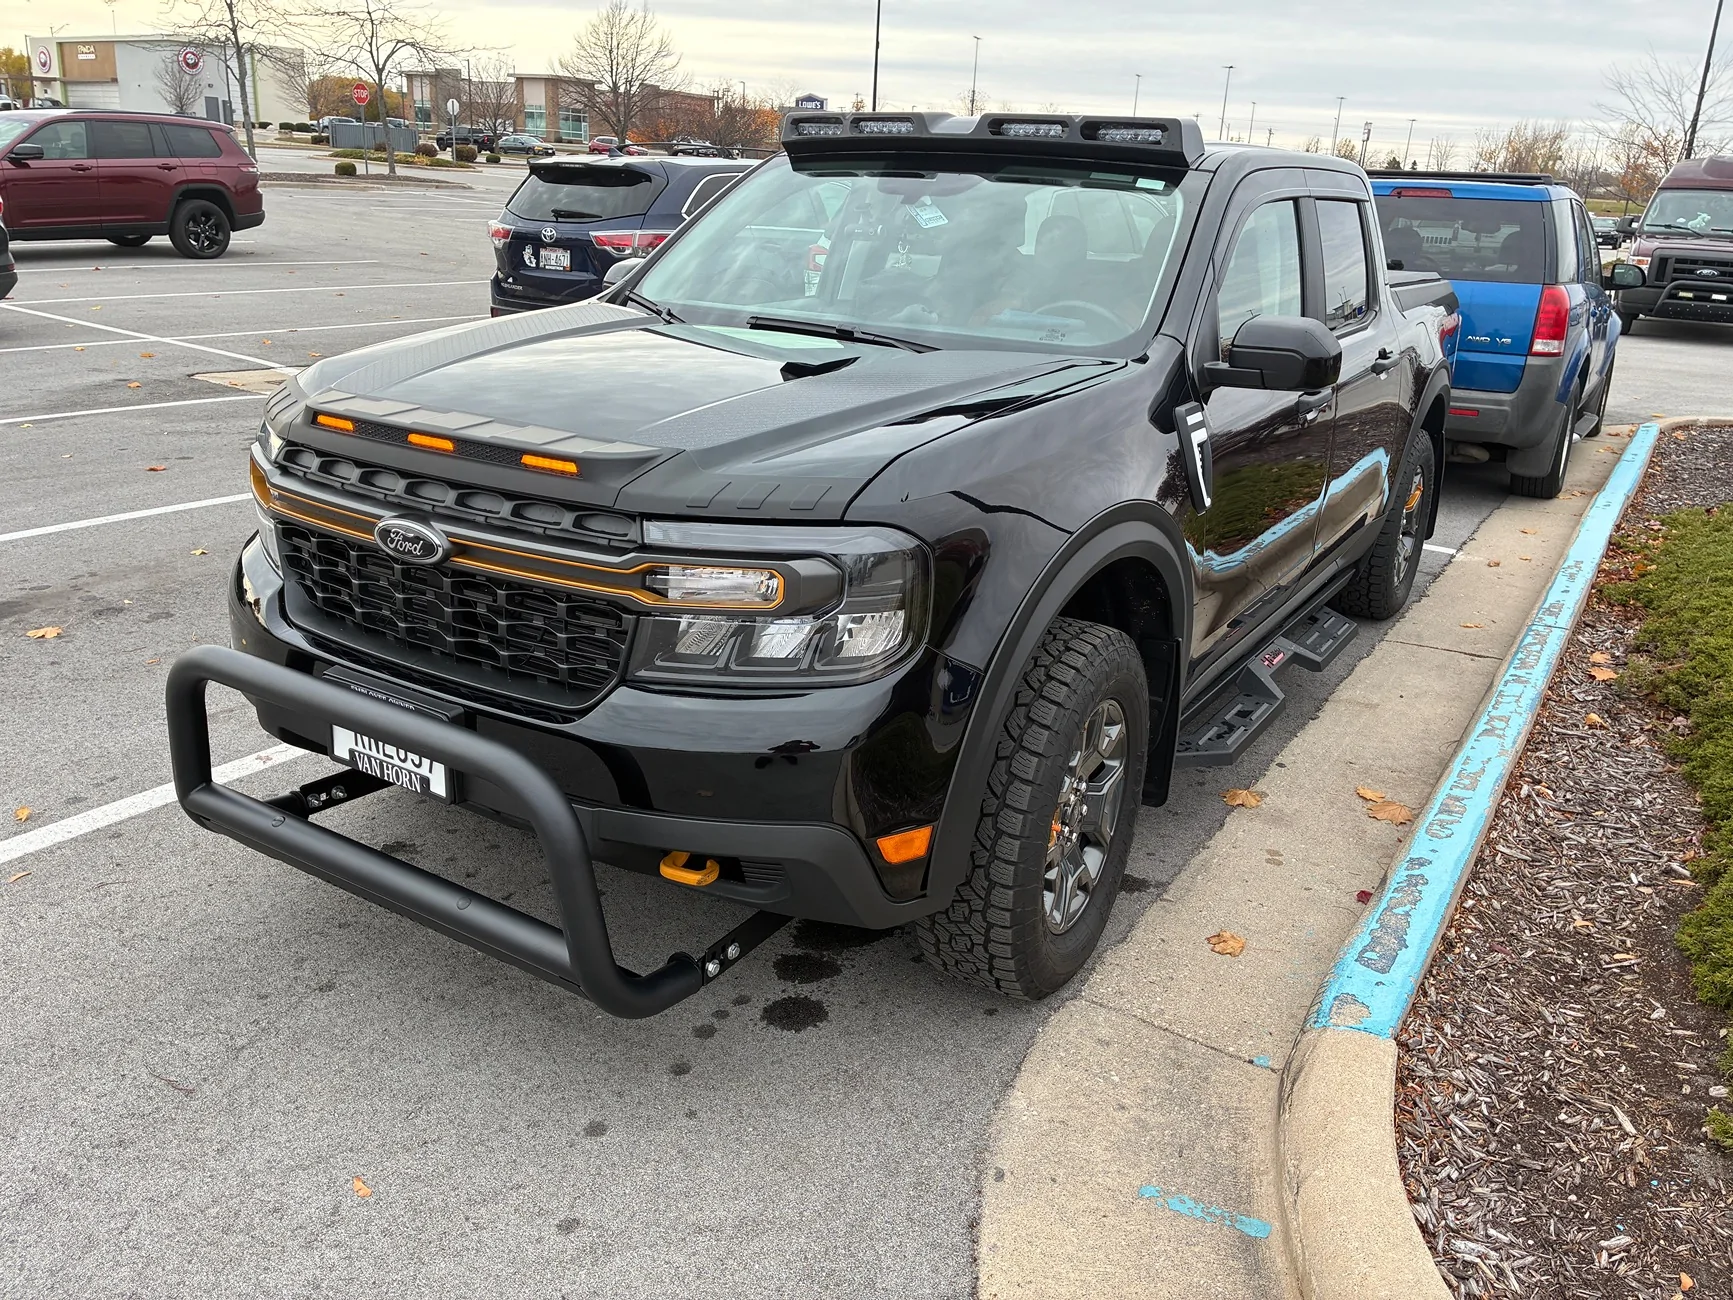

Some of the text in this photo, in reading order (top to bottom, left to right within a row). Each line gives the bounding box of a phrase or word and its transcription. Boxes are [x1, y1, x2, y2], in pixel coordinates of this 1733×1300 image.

[354, 88, 368, 98] STOP
[799, 100, 821, 109] LOWE'S
[1465, 335, 1491, 343] AWD
[387, 528, 424, 556] Ford
[354, 751, 381, 778] VAN
[382, 761, 421, 793] HORN
